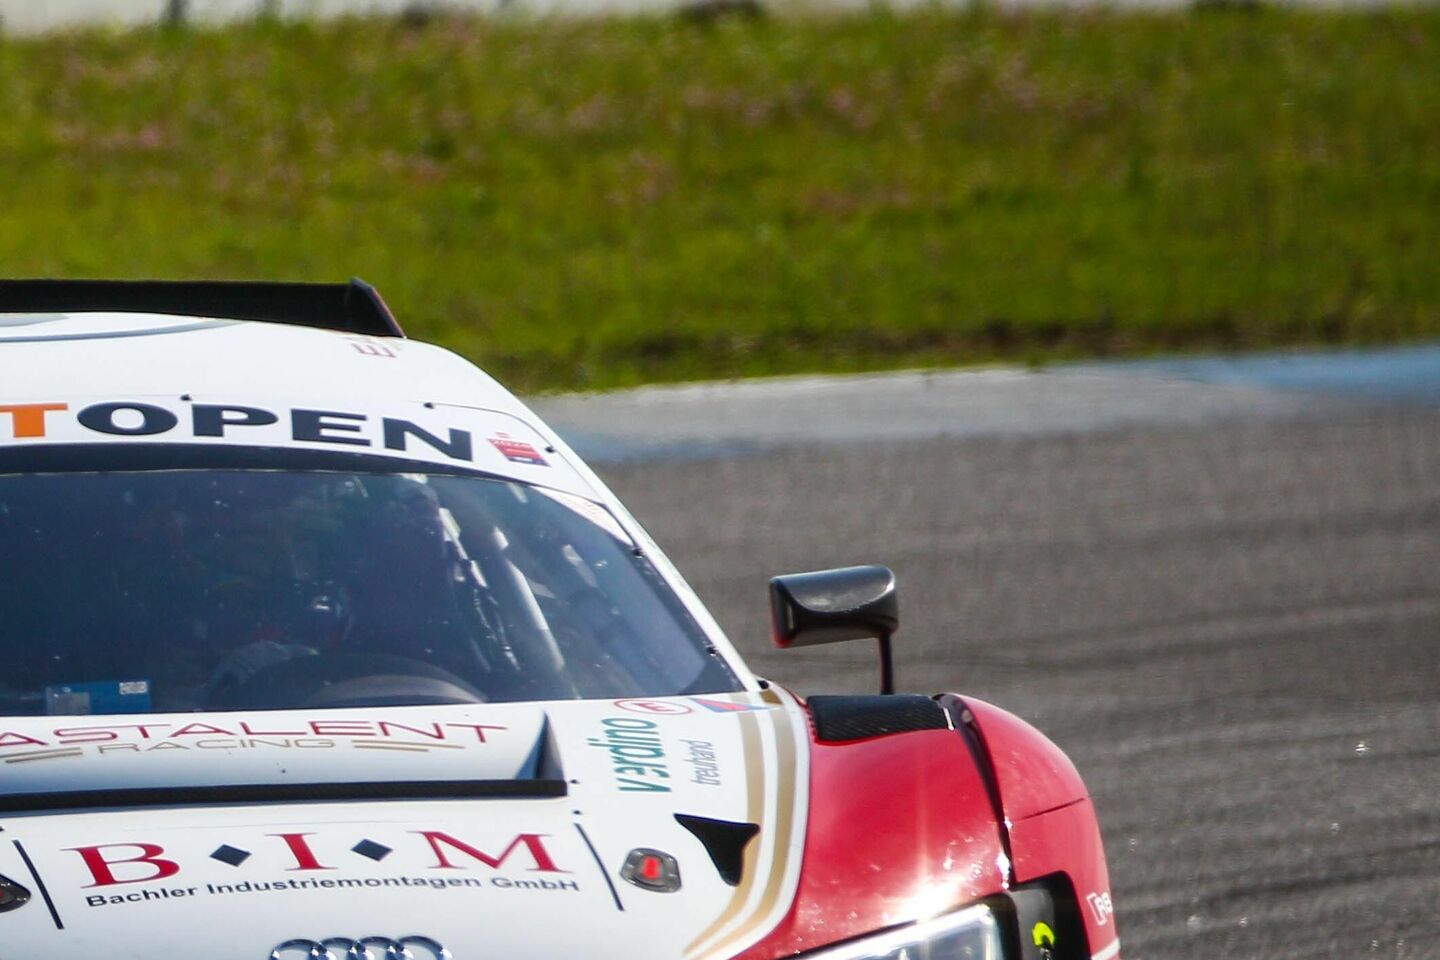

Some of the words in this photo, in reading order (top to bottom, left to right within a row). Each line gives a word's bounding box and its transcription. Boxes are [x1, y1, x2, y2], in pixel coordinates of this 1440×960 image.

[97, 735, 335, 755] RACING
[679, 738, 721, 786] treuhand
[85, 884, 198, 909] Bachler
[207, 876, 480, 897] Industriemontagen
[492, 876, 580, 894] GmbH
